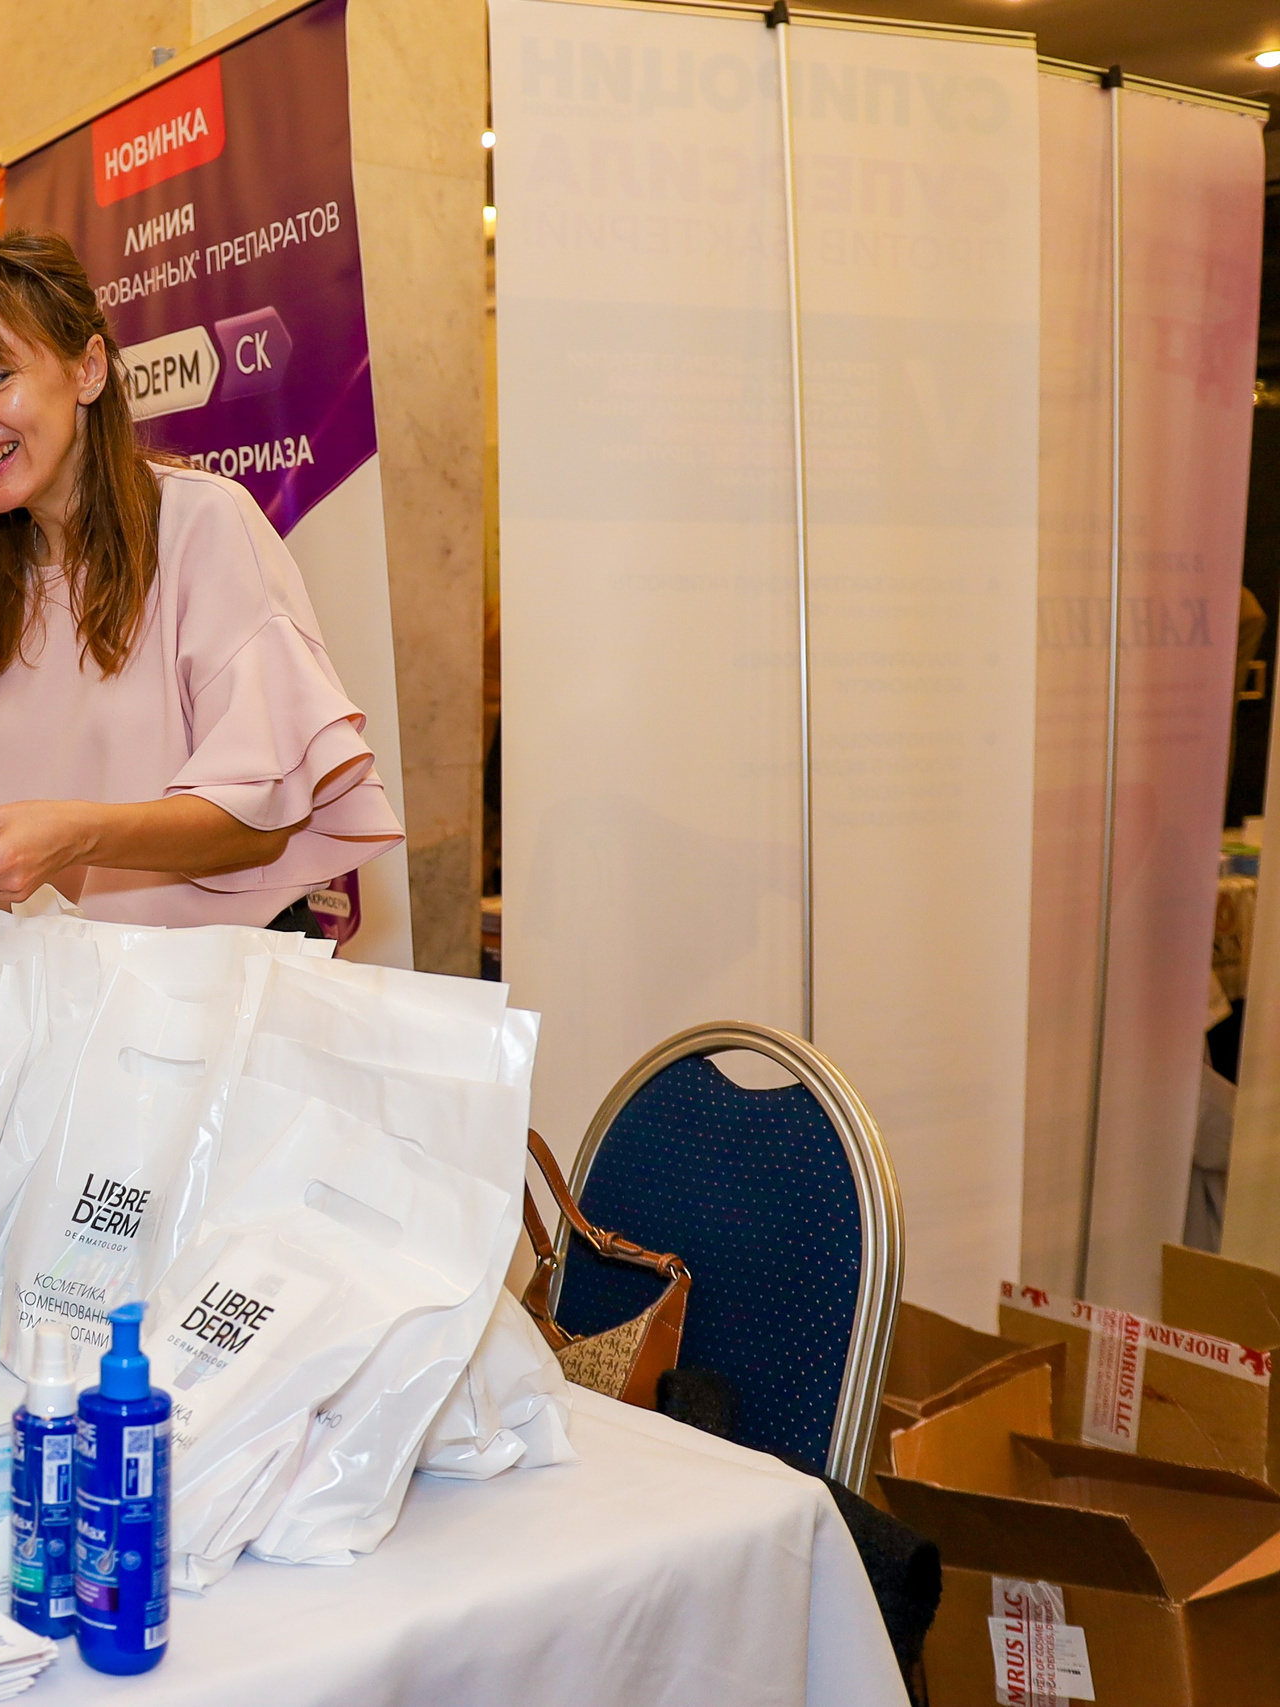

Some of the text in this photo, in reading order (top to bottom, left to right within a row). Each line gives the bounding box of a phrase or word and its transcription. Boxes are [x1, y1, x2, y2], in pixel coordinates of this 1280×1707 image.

[105, 107, 209, 180] НОВИНКА
[124, 203, 195, 256] ЛИНИЯ
[206, 201, 340, 275] ПРЕПАРАТОВ
[236, 330, 272, 374] СК
[190, 435, 315, 477] ПСОРИАЗА
[82, 1173, 151, 1213] LIBRE
[71, 1198, 141, 1239] DERM
[64, 1229, 128, 1253] DERMATOLOGY
[33, 1272, 107, 1304] КОСМЕТИКА,
[200, 1281, 275, 1331] LIBRE
[167, 1334, 229, 1369] DERMATOLOGY
[180, 1306, 254, 1354] DERM
[1116, 1401, 1134, 1438] LLC
[1003, 1592, 1026, 1707] MRUS LLC
